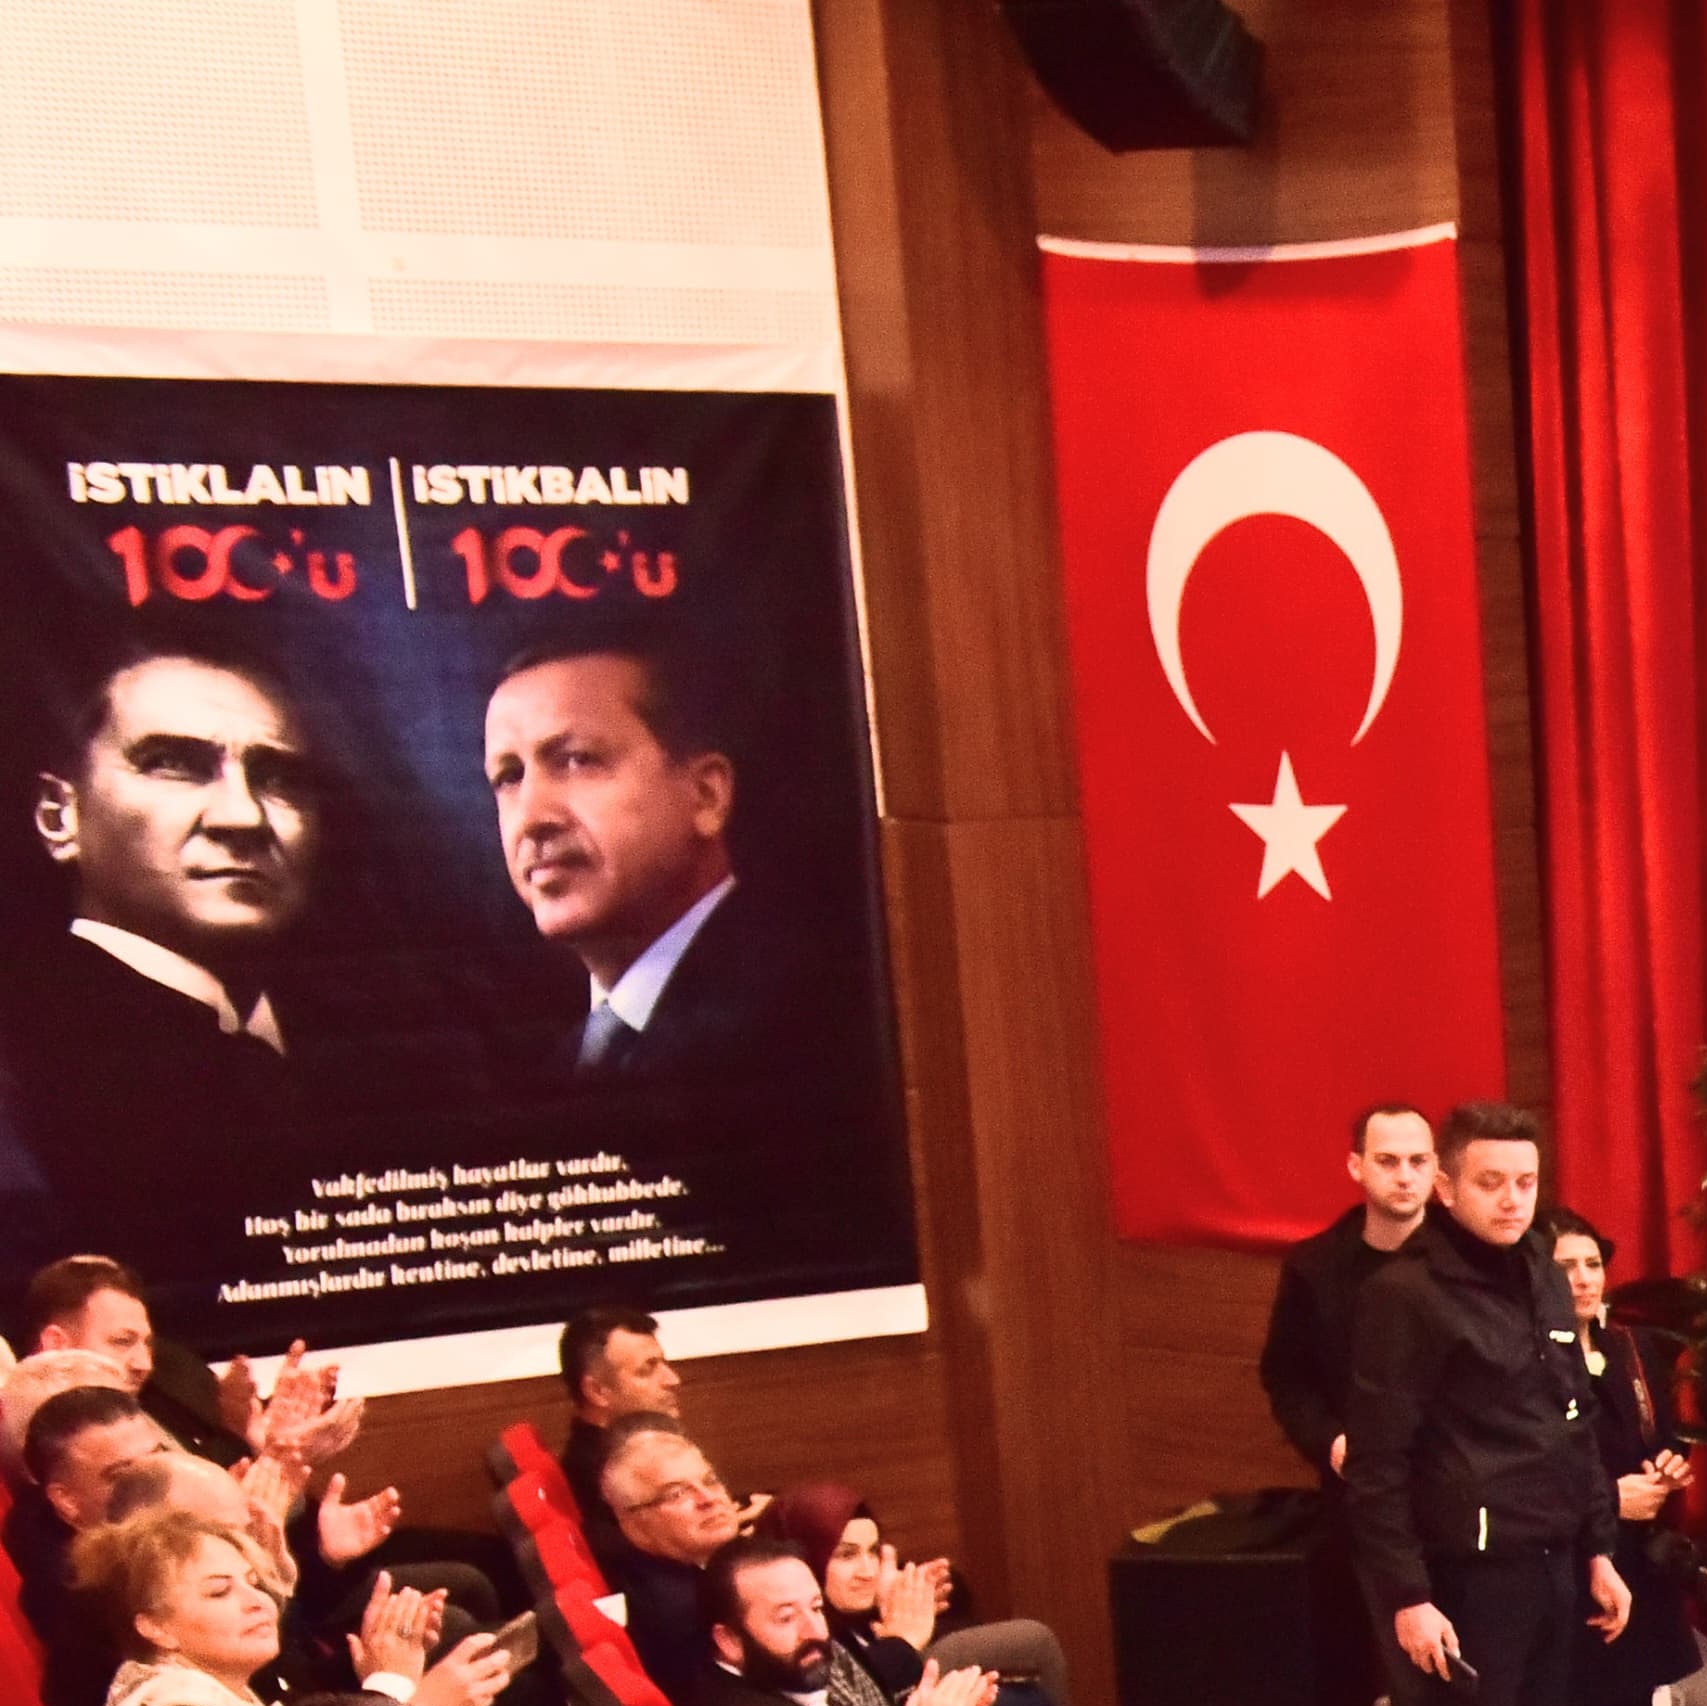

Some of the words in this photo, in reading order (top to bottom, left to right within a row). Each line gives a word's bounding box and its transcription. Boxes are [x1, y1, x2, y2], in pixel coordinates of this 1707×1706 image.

[295, 1209, 329, 1232] bir
[335, 1203, 393, 1227] sada
[495, 1190, 543, 1216] diye
